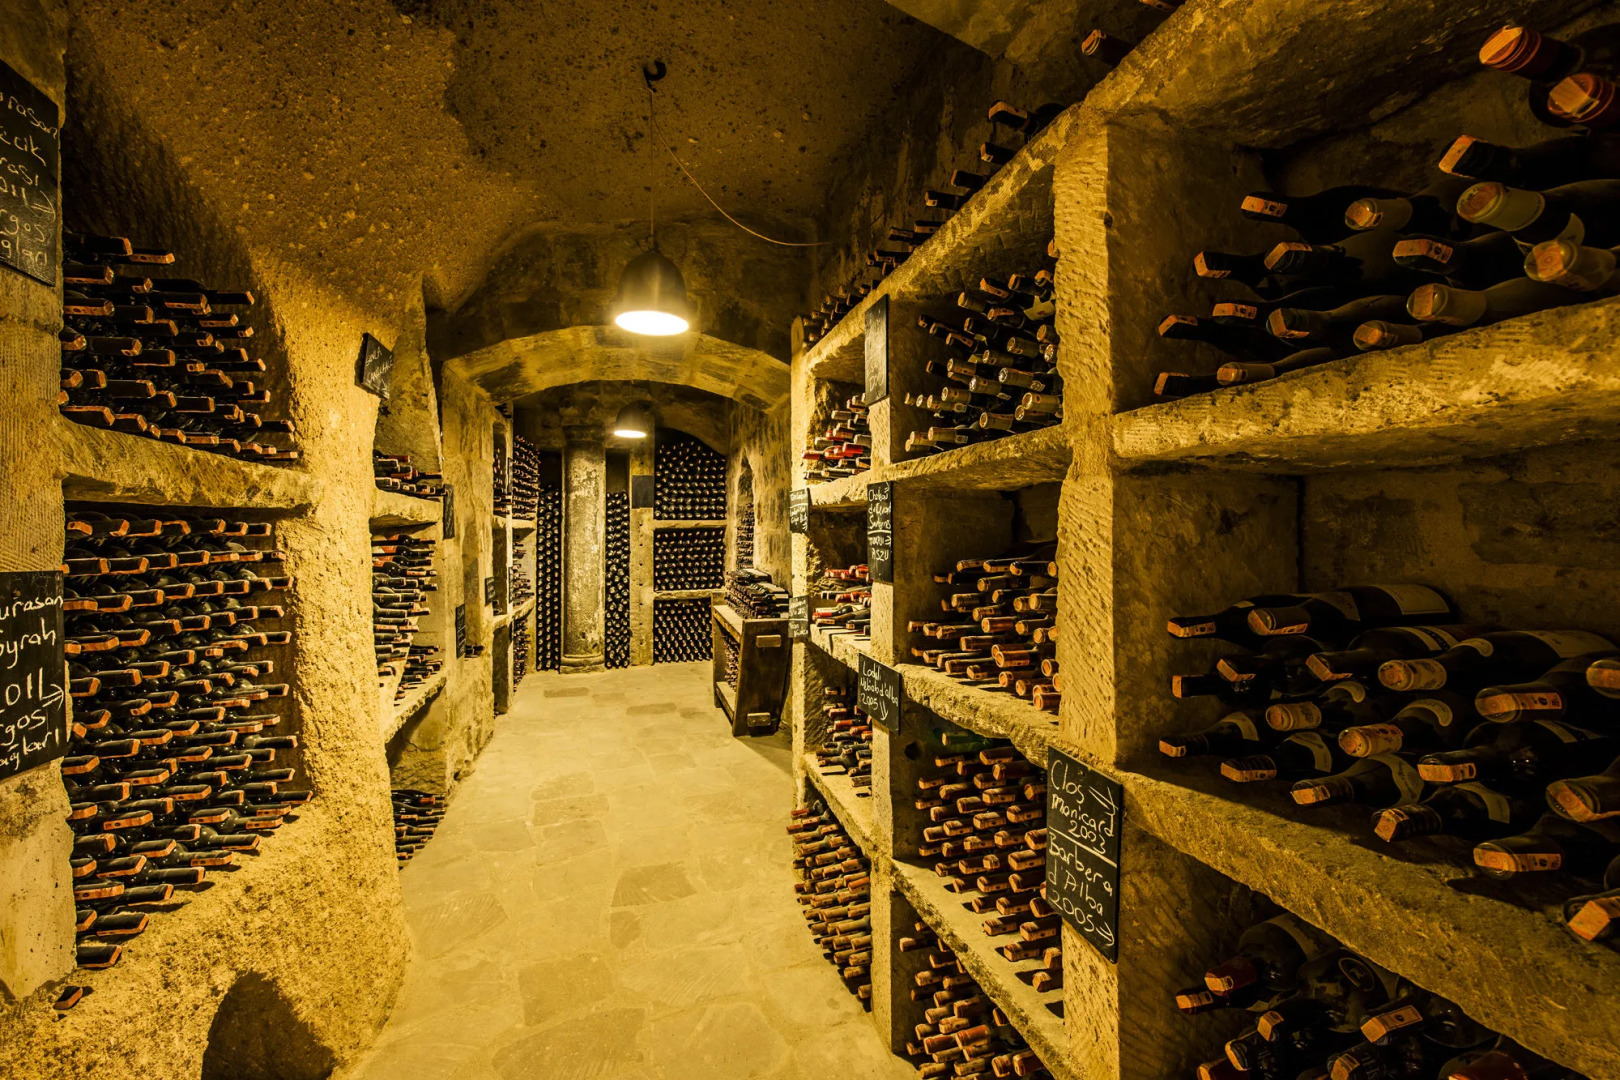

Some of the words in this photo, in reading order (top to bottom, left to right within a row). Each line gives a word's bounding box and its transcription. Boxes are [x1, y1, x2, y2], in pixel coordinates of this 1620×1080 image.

[0, 666, 44, 714] 011
[860, 692, 879, 711] 2005
[1051, 759, 1085, 804] Clos
[1068, 819, 1106, 855] 2003
[1049, 832, 1113, 897] Barbera
[1049, 859, 1103, 916] d'Alba
[1049, 891, 1095, 933] 2005
